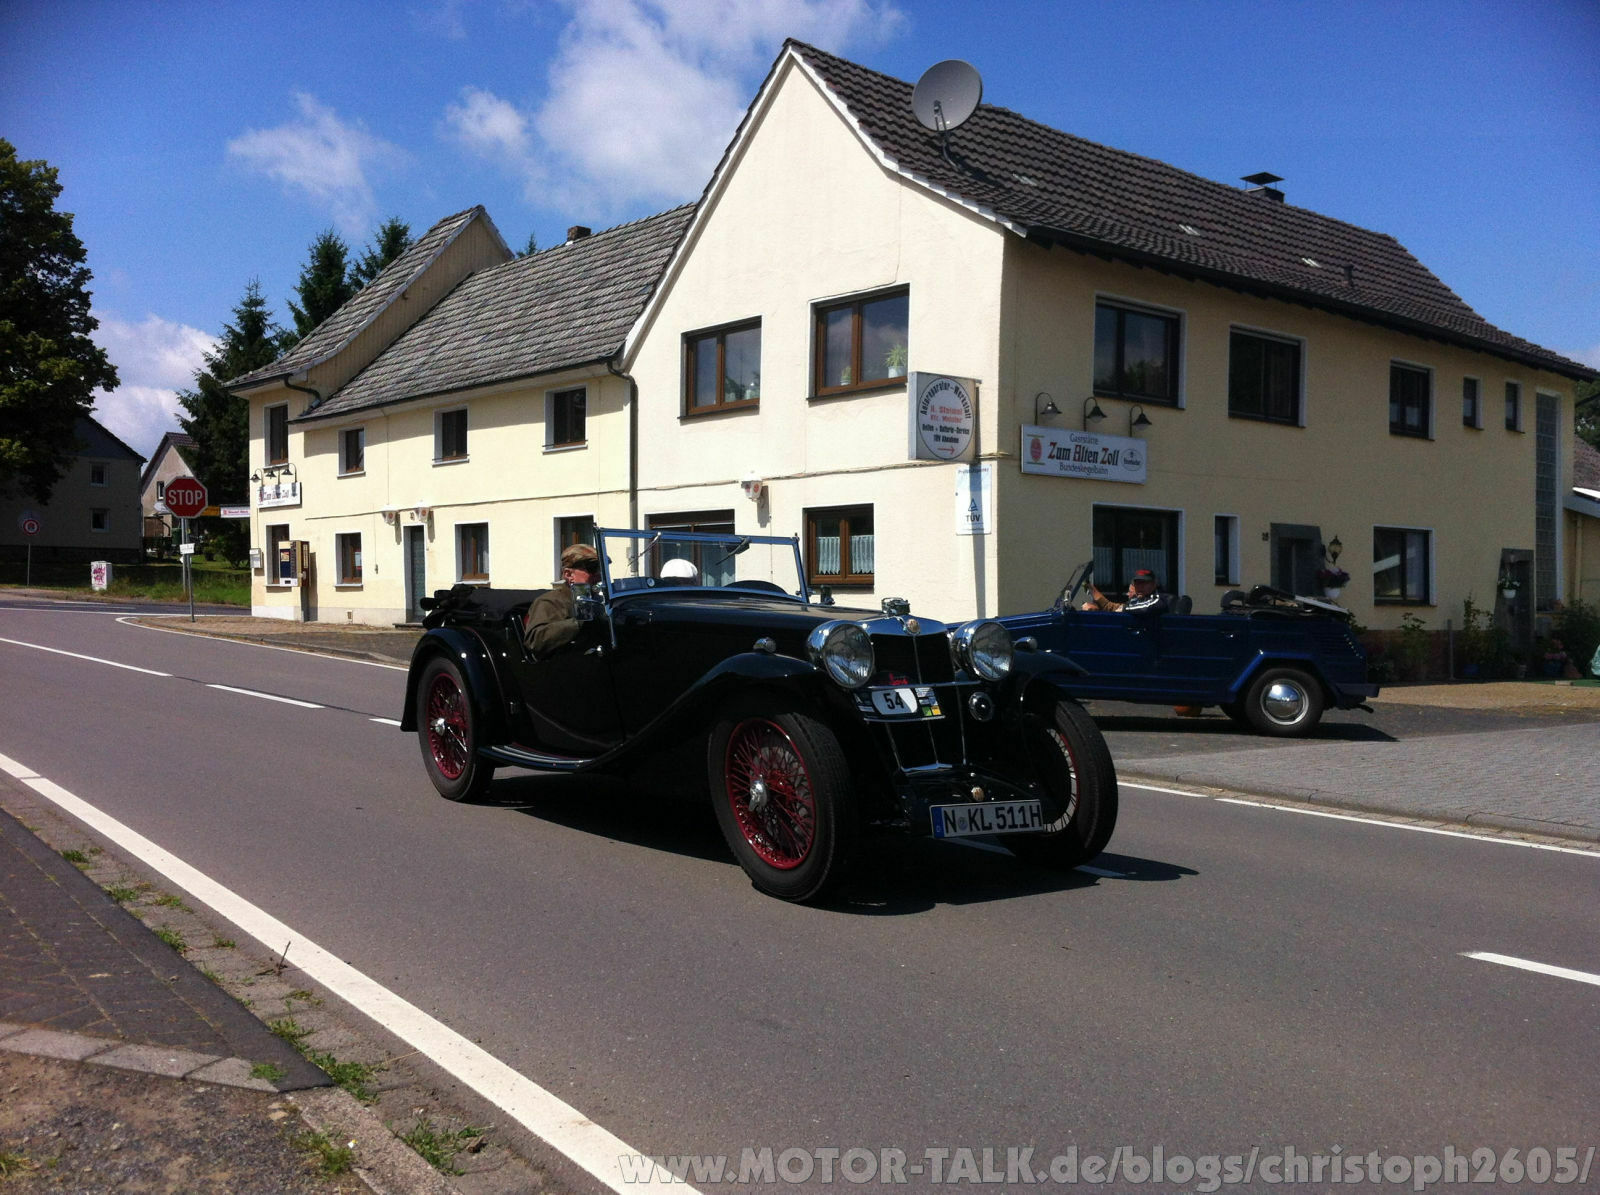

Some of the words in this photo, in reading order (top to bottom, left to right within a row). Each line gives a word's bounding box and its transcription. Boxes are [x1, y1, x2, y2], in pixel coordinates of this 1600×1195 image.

[1047, 441, 1071, 460] Zum
[1073, 444, 1099, 464] Alten
[1100, 447, 1119, 466] Zoll
[168, 489, 203, 506] STOP
[965, 513, 981, 522] TÜV
[883, 692, 904, 710] 54
[943, 809, 957, 833] N
